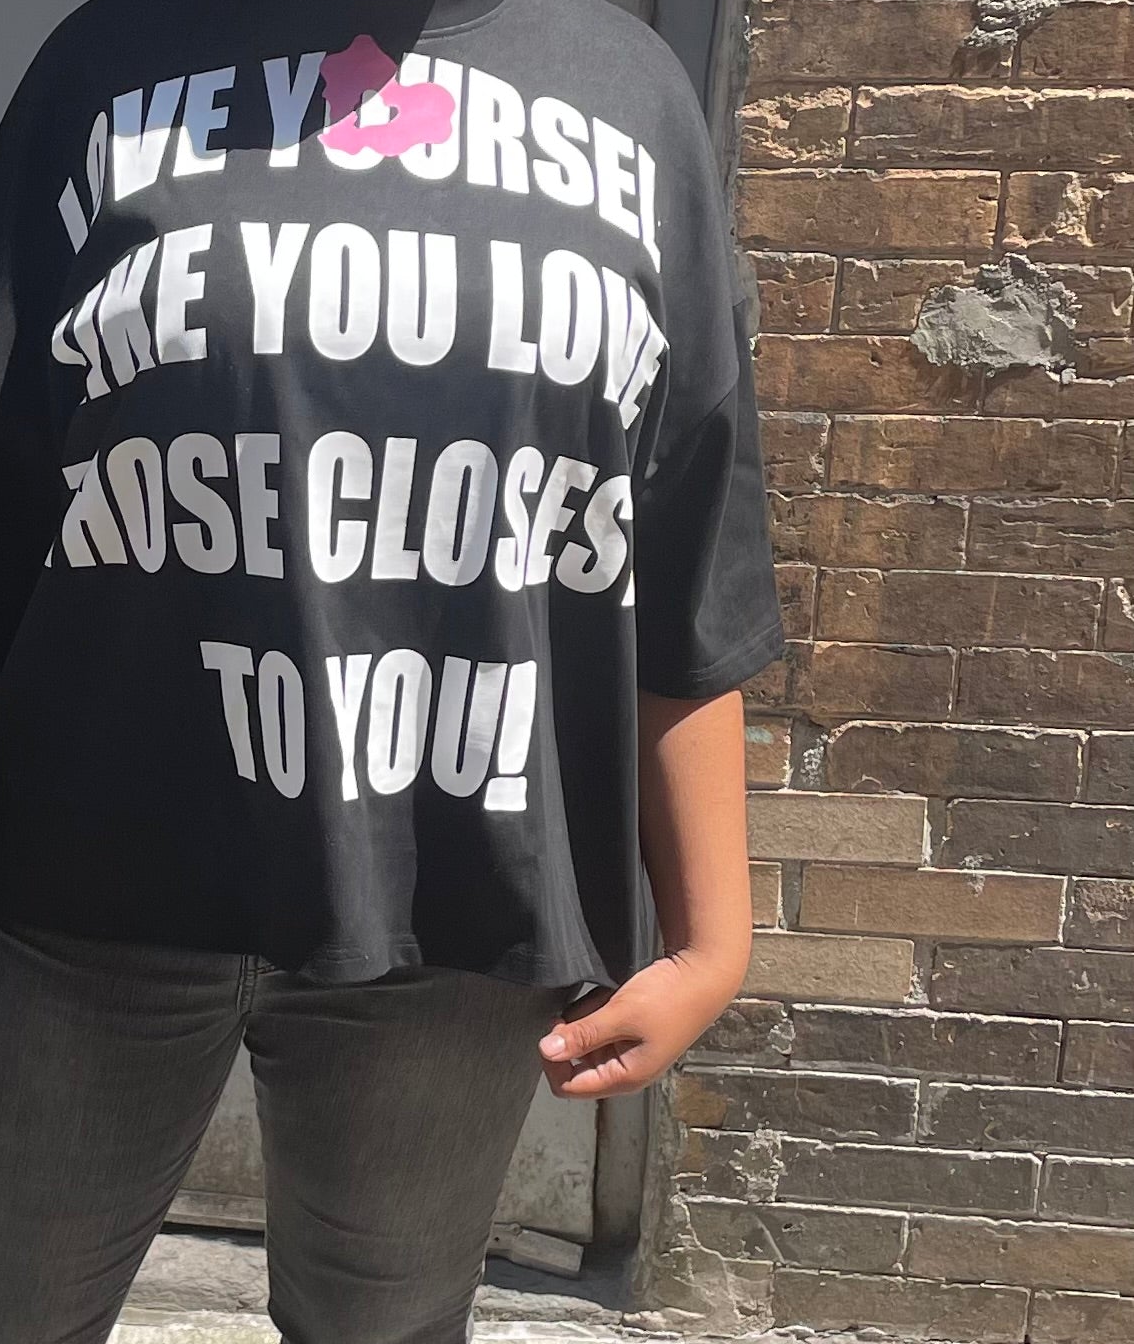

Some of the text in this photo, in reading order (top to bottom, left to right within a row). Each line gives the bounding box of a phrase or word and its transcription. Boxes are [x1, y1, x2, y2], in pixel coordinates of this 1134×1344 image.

[262, 51, 662, 273] YURSEL
[52, 222, 670, 430] LIKE YOU LOVE
[44, 430, 635, 607] HOSE CLOSES
[200, 641, 537, 812] TO YOU!
